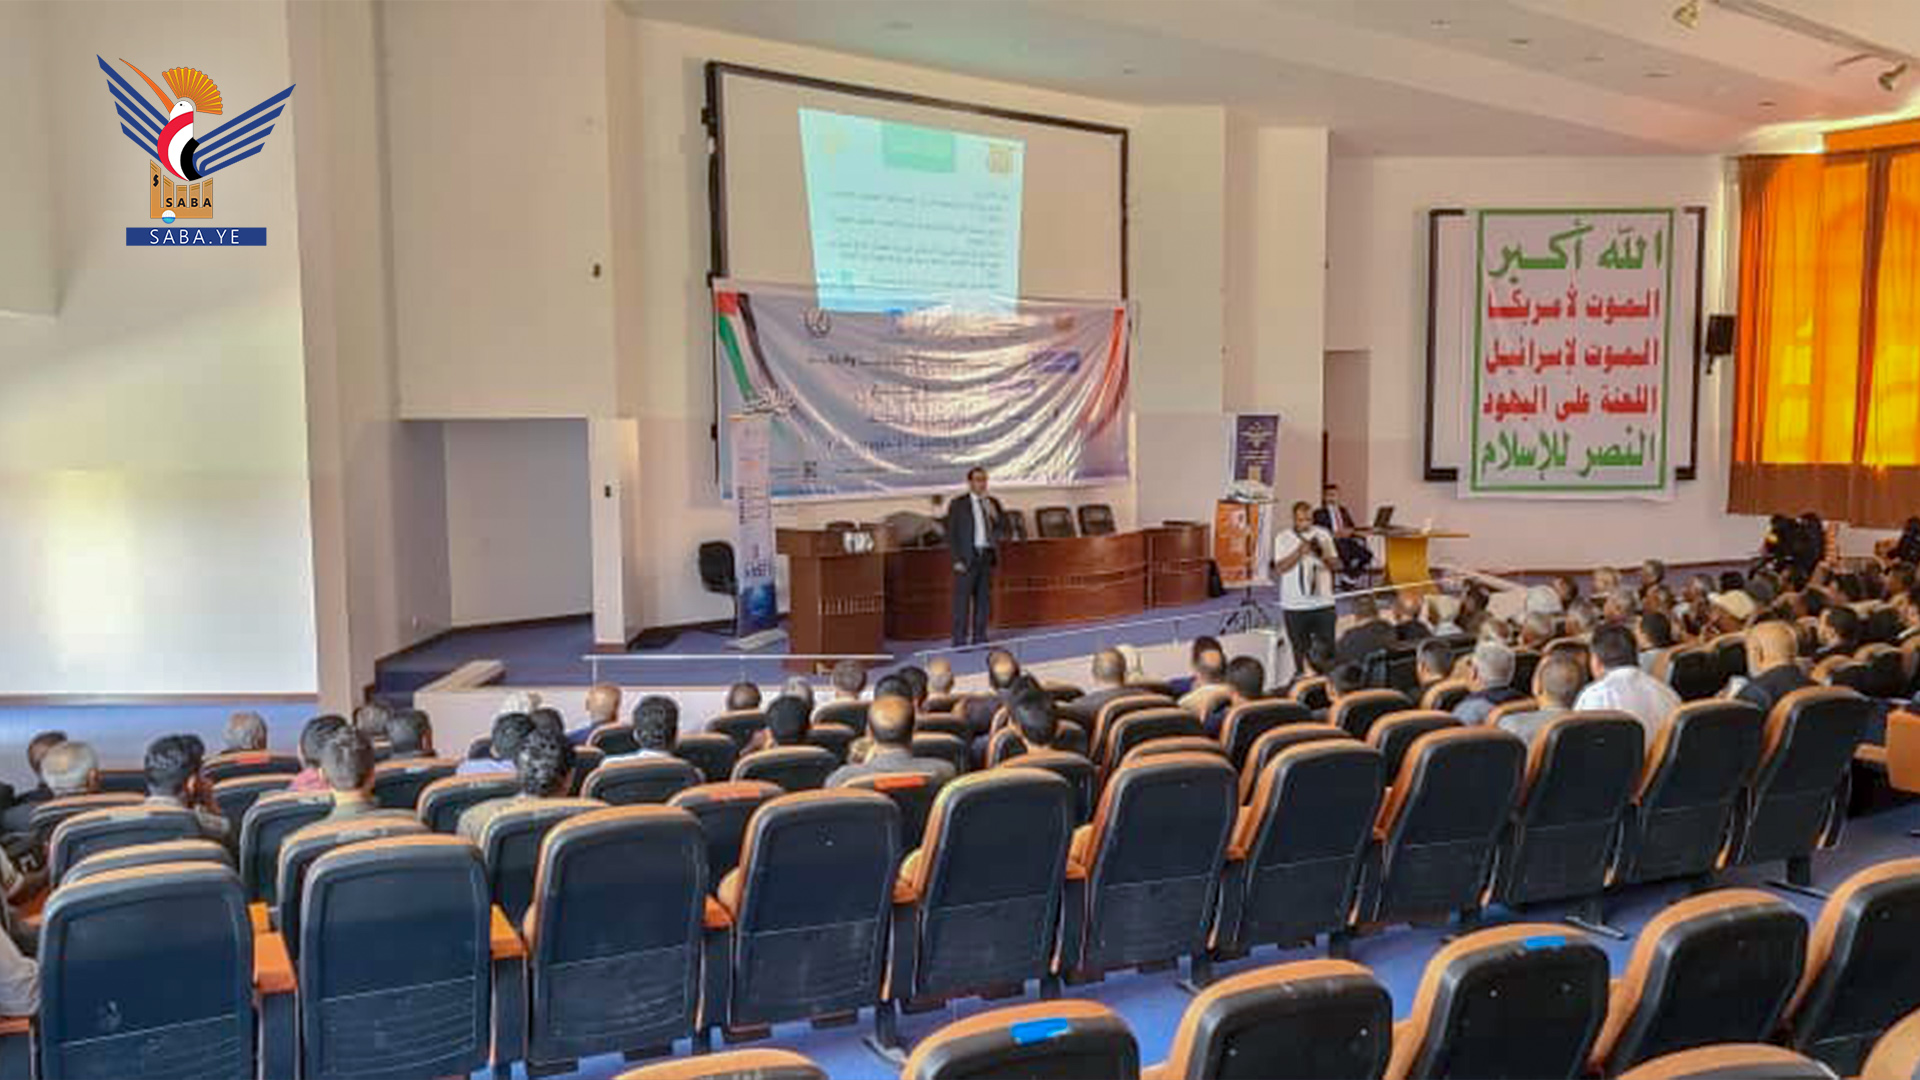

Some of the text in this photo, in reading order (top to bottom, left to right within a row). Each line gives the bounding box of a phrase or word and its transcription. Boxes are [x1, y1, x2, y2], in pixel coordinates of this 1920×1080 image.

[1585, 288, 1660, 324] الموت
[1584, 338, 1659, 373] الموت
[1483, 384, 1657, 422] اللعنة على اليهود
[1578, 425, 1656, 477] النصر
